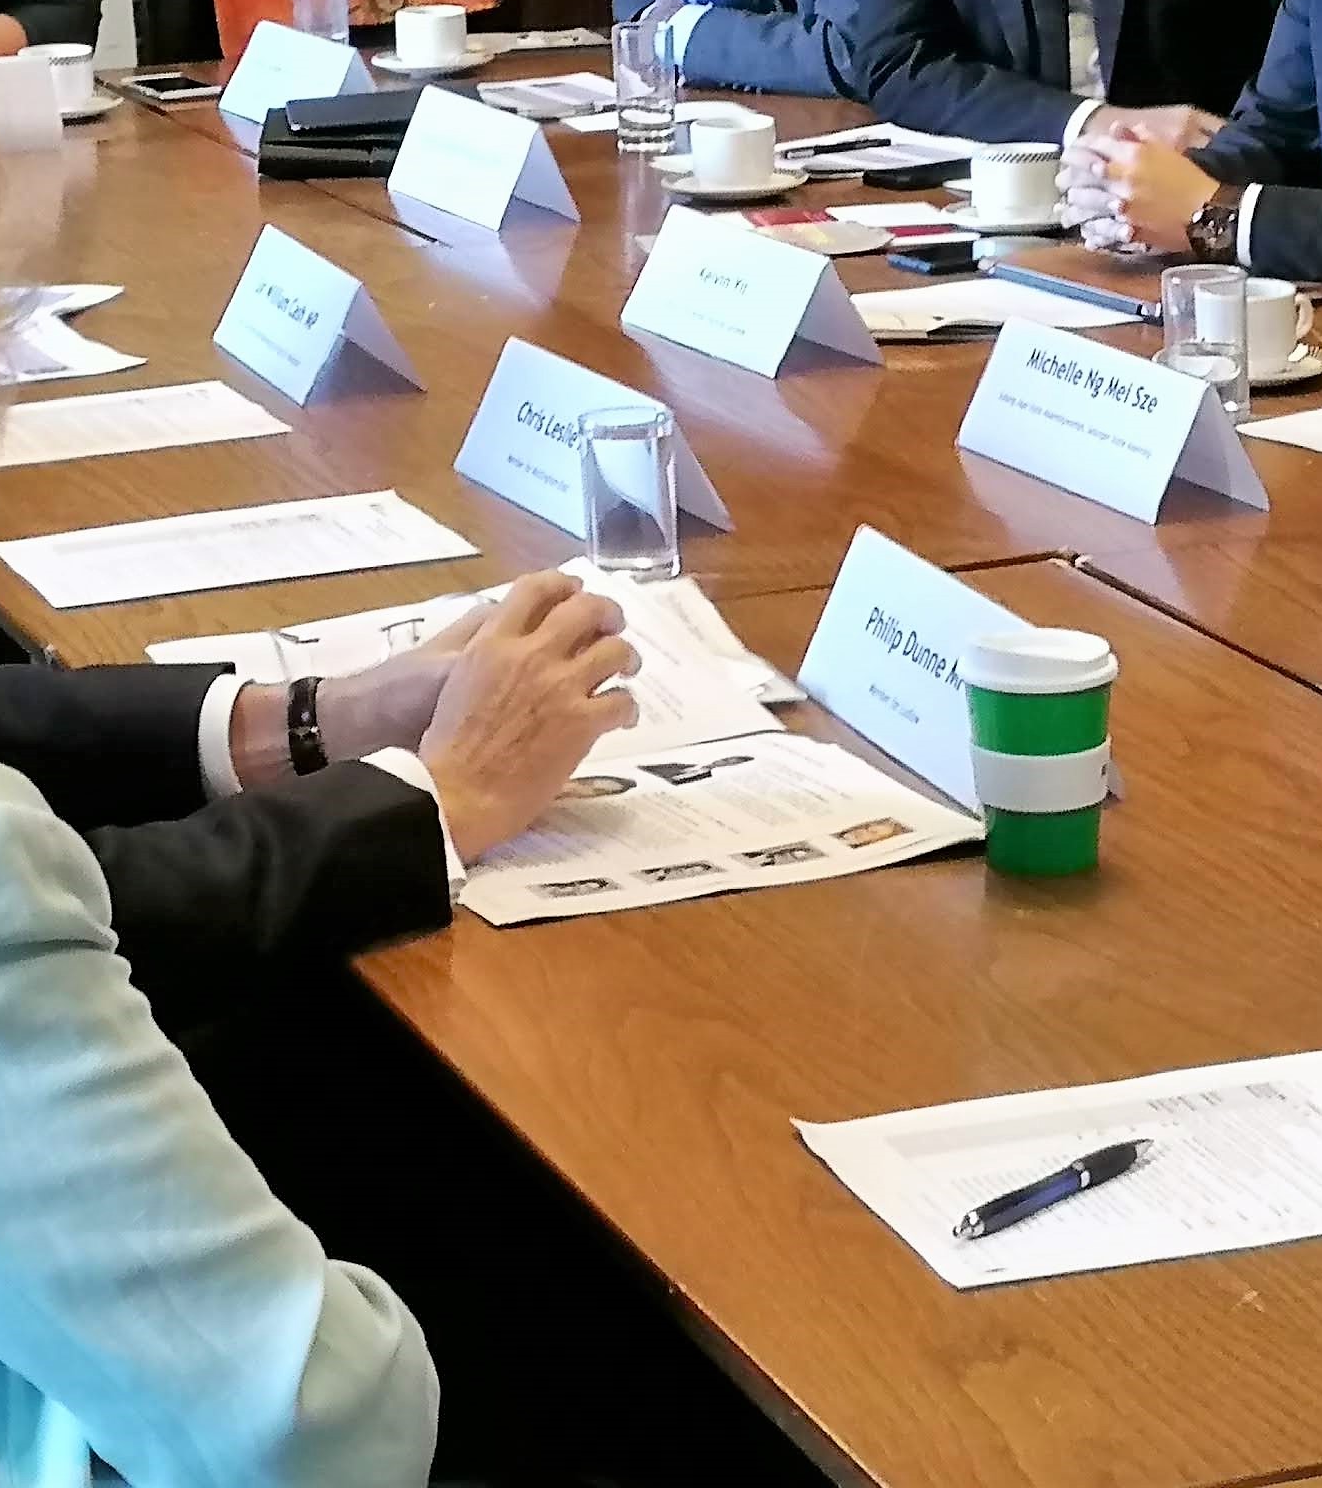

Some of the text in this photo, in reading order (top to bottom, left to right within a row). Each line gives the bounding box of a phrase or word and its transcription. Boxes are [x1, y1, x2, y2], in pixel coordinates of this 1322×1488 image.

[1025, 347, 1083, 386] Michelle
[1084, 367, 1105, 398] Ng
[1132, 385, 1158, 414] Sze
[516, 400, 546, 432] Chris
[864, 605, 903, 654] Philip
[902, 629, 947, 679] Dunne
